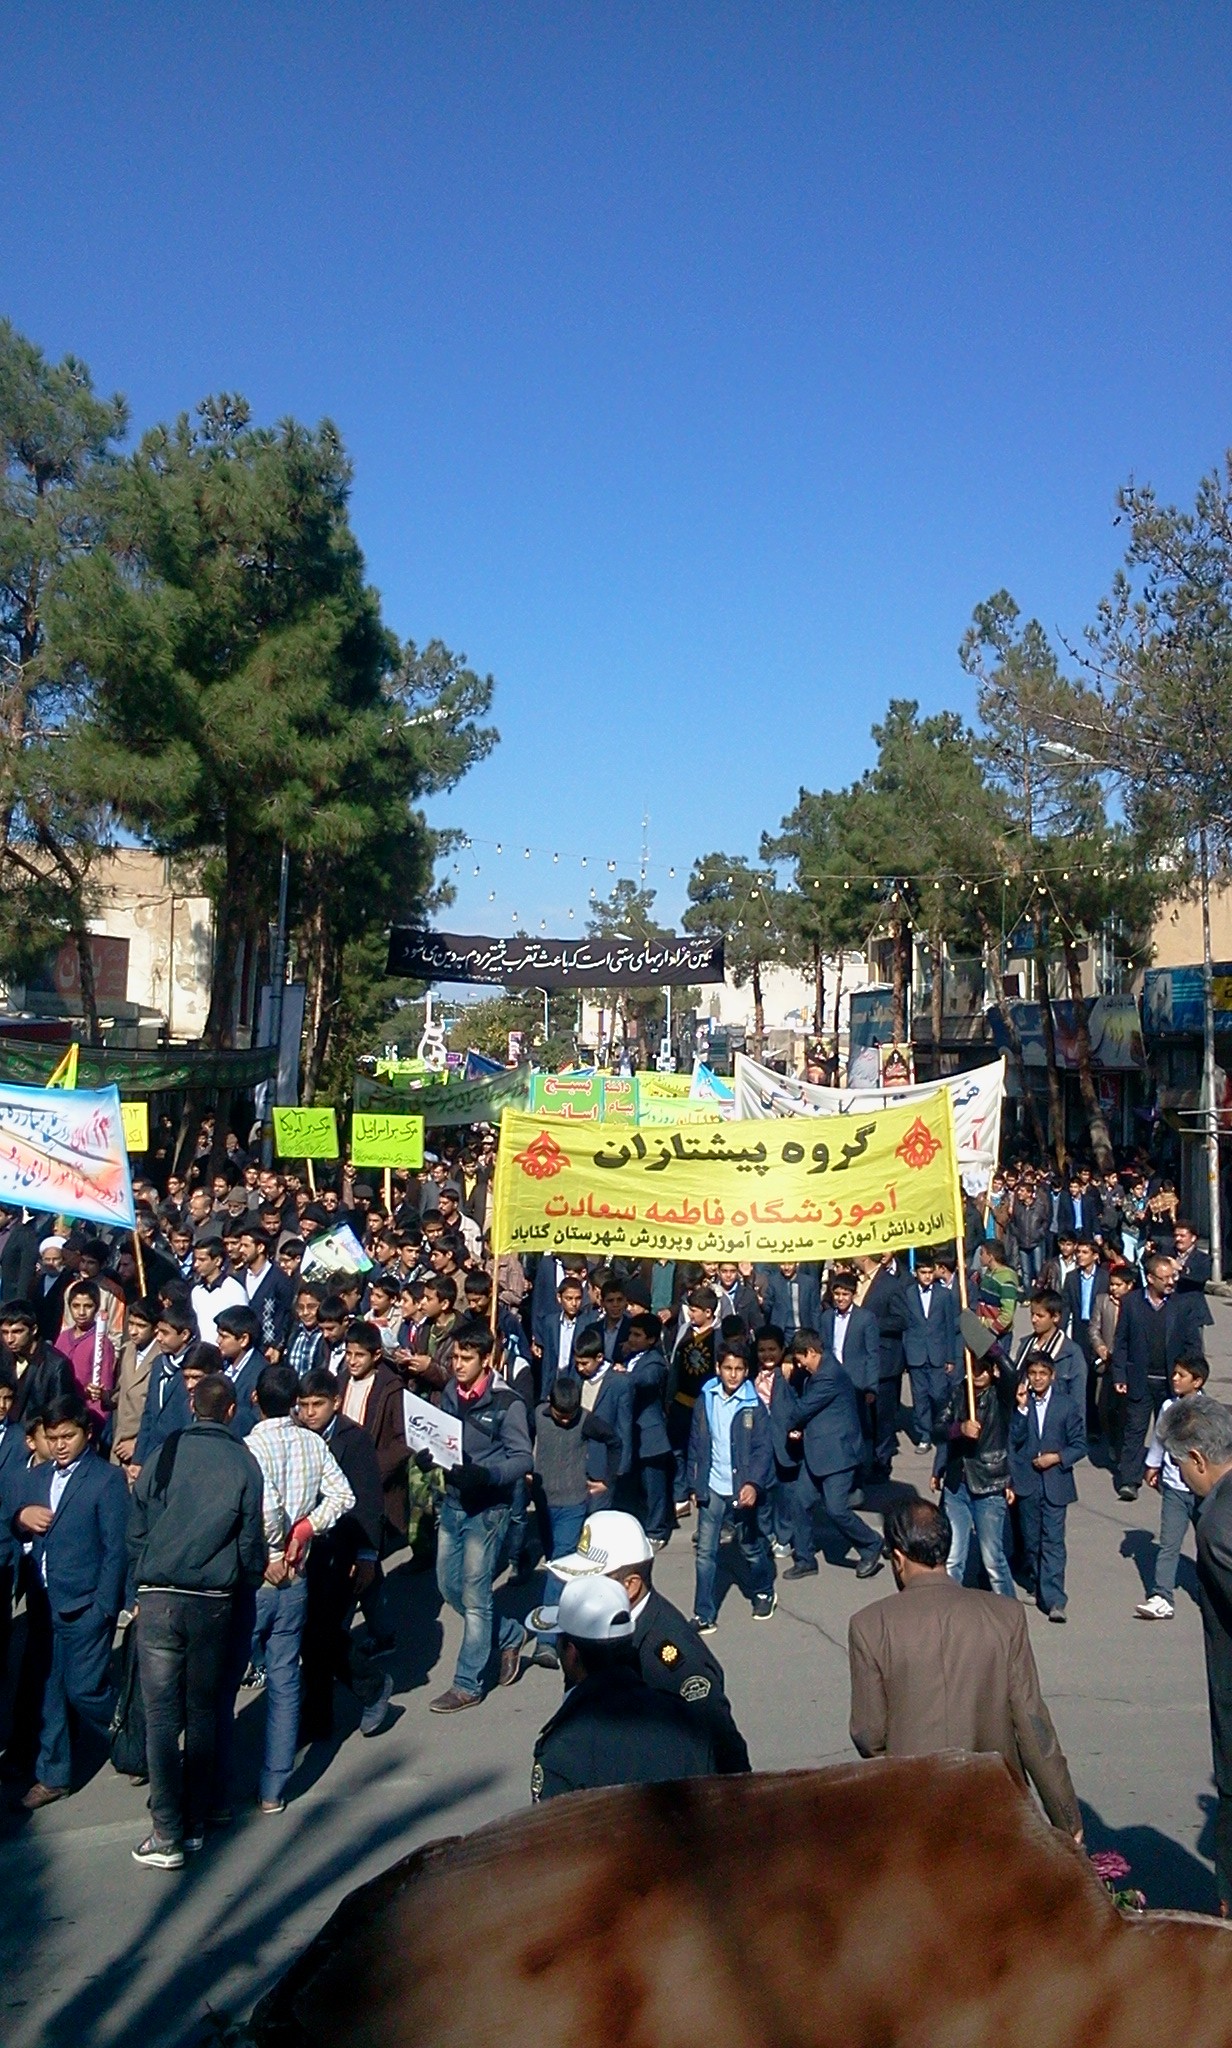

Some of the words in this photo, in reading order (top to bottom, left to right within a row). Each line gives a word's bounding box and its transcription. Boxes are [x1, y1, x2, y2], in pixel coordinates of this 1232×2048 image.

[432, 949, 457, 968] دین
[465, 949, 492, 970] مردم
[481, 939, 508, 972] بیشتر
[501, 944, 542, 973] تقرب
[532, 949, 568, 974] باعث
[567, 944, 591, 967] که
[575, 951, 611, 970] است
[608, 947, 634, 973] سنتی
[544, 1076, 593, 1096] بسیج
[593, 1132, 770, 1177] پیشتازان
[781, 1121, 877, 1175] گروه
[544, 1192, 637, 1221] سعادت
[645, 1197, 726, 1226] فاطمه
[731, 1181, 898, 1227] آموزشگاه
[511, 1222, 551, 1244] گناباد
[832, 1222, 877, 1249] آموزی
[881, 1218, 915, 1243] دانش
[918, 1211, 945, 1236] اداره
[553, 1226, 626, 1247] شهرستان
[697, 1230, 751, 1253] آموزش
[756, 1236, 815, 1253] مدیریت
